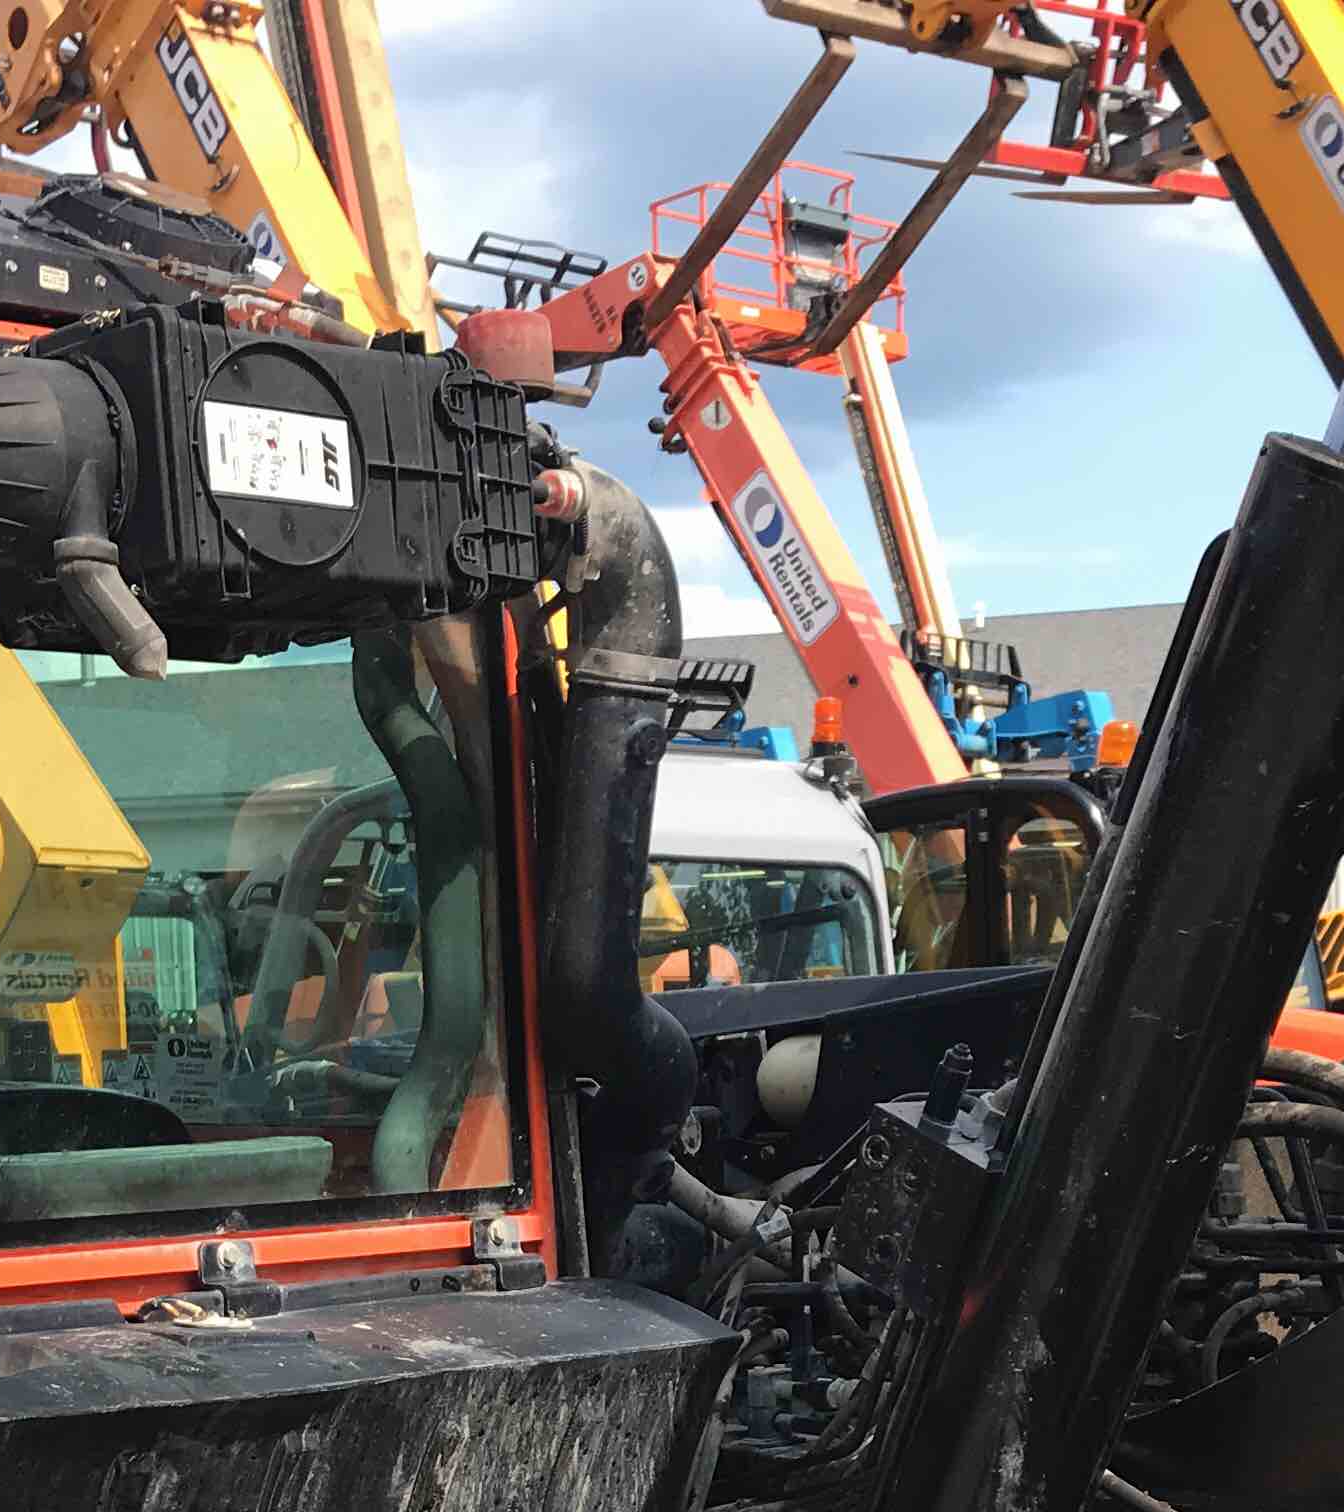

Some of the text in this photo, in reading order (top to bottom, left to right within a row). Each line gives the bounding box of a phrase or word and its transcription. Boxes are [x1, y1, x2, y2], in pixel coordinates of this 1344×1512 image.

[1232, 0, 1301, 79] CB
[159, 35, 227, 156] JCB
[321, 431, 340, 491] JLG
[769, 552, 815, 632] Rentals
[783, 537, 828, 611] United
